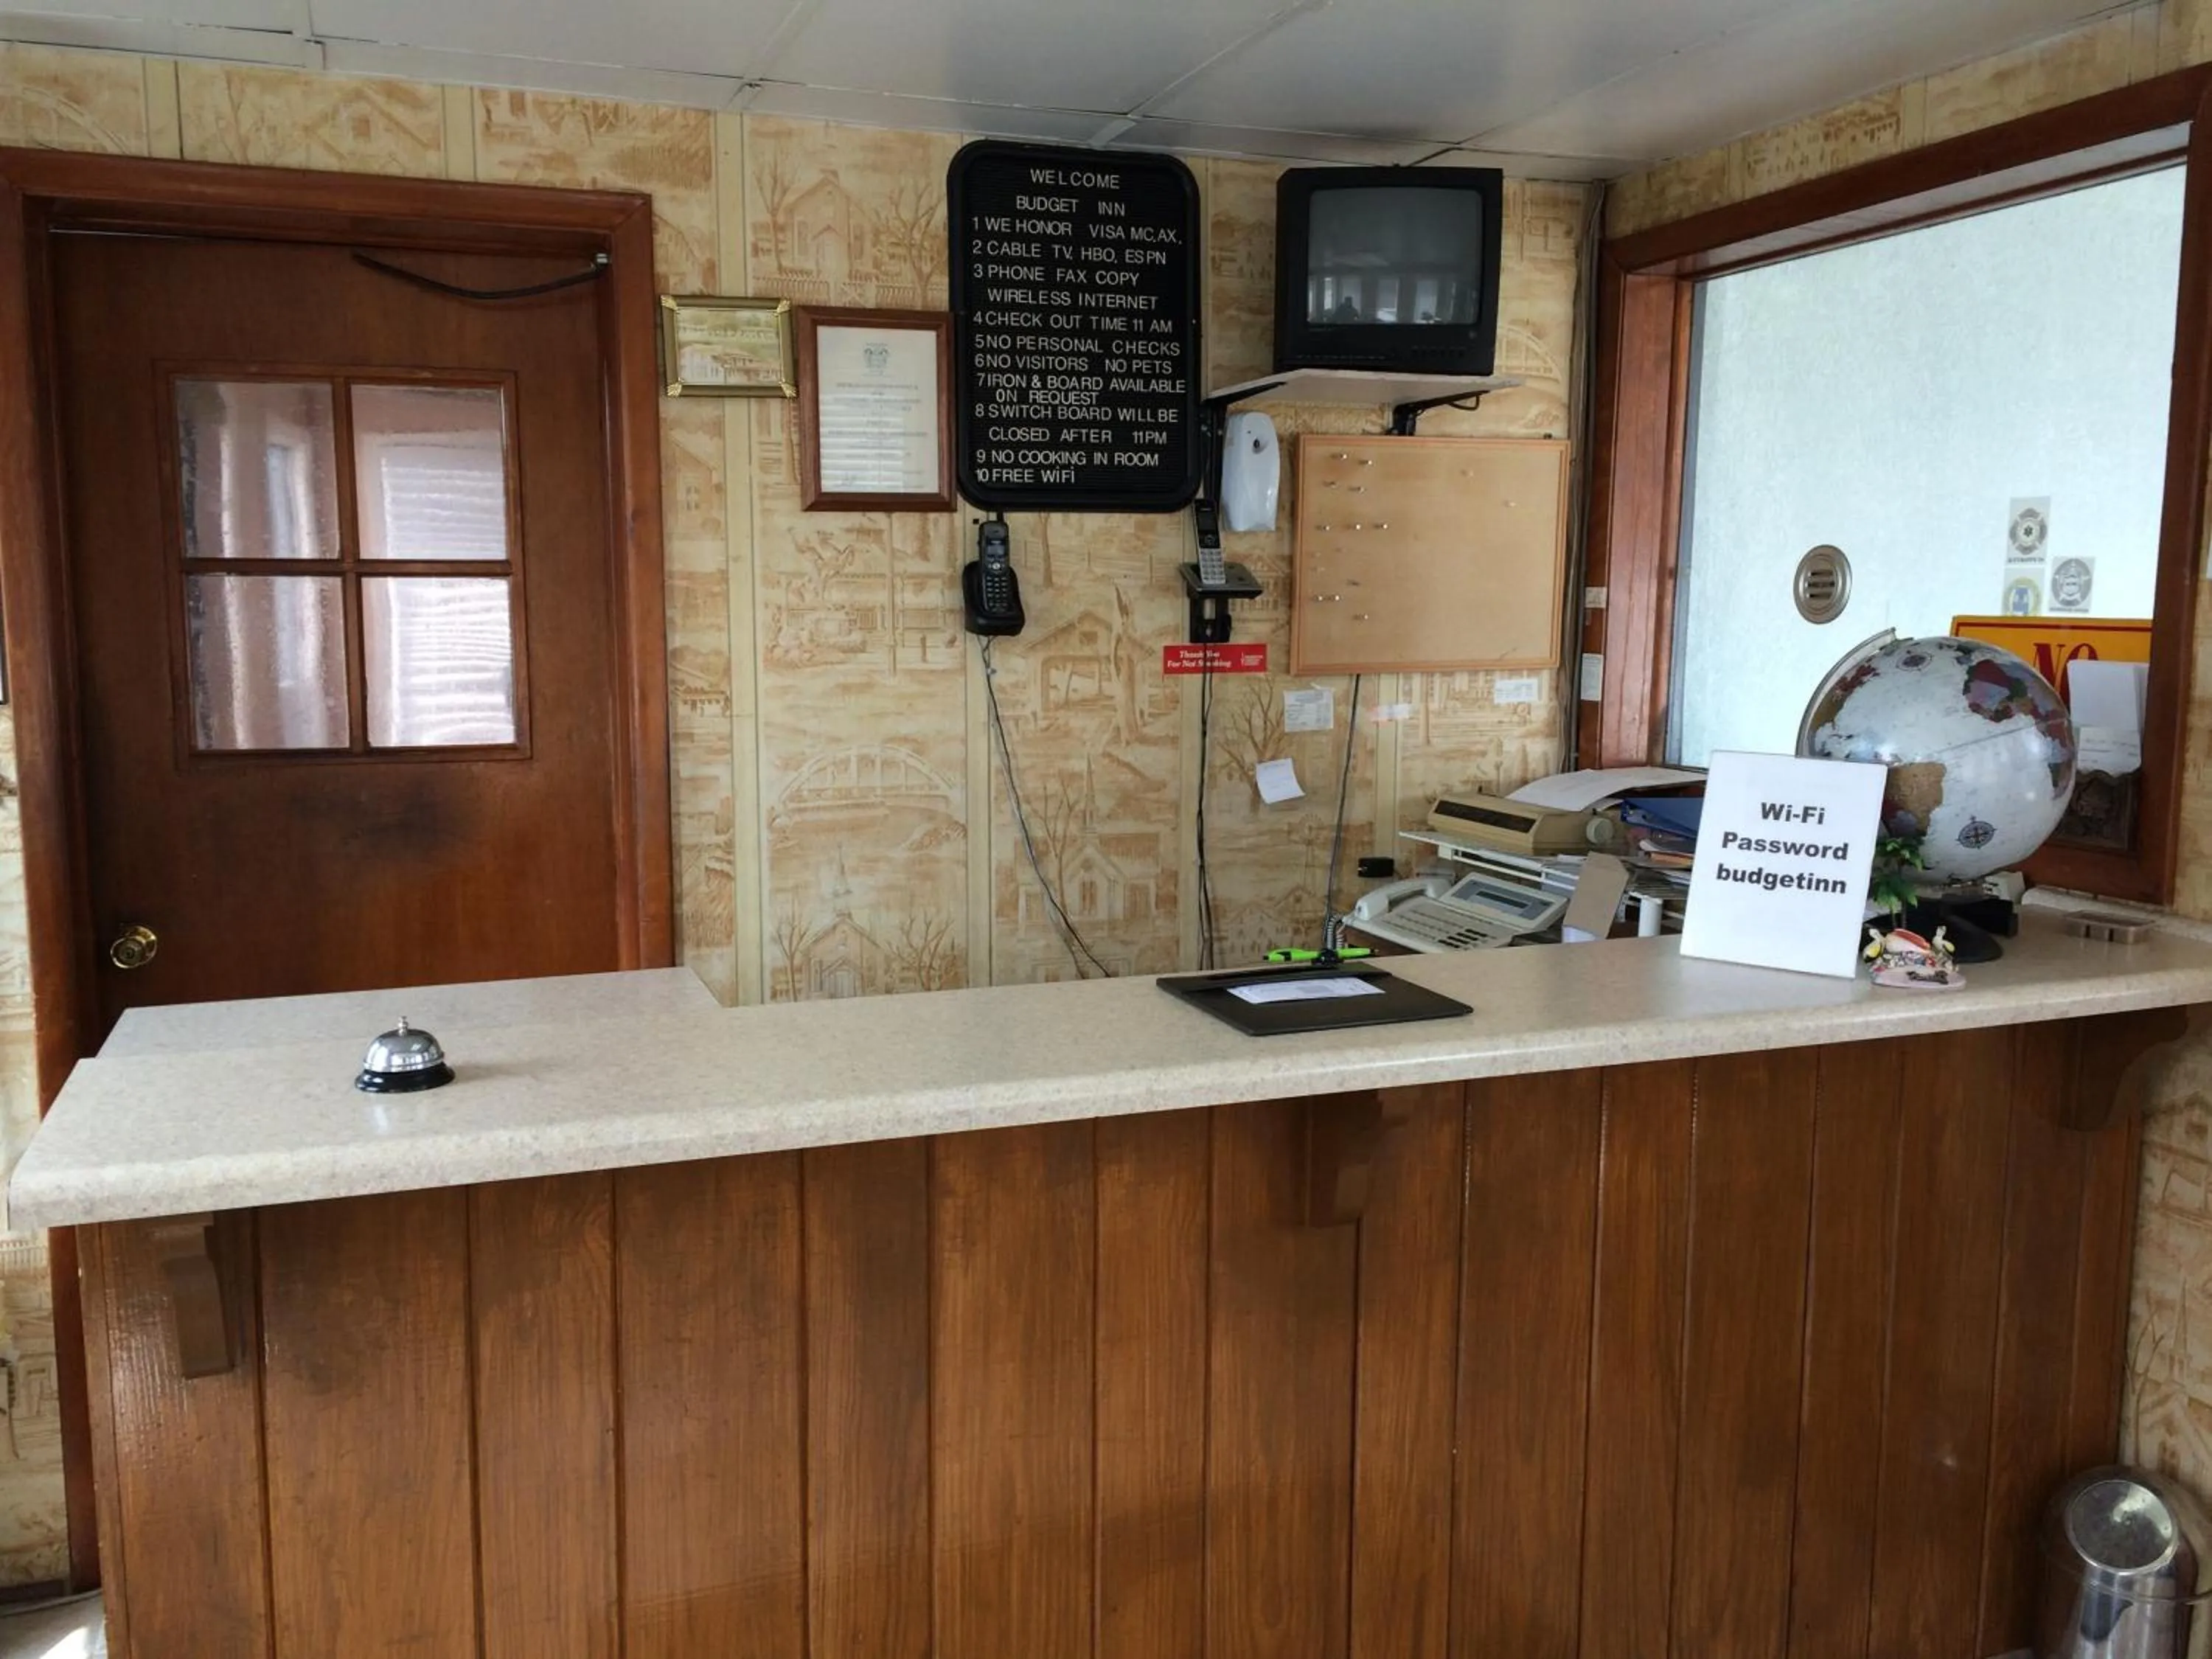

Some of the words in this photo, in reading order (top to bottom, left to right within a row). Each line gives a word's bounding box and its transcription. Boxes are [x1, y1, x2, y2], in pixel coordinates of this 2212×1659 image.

[1031, 170, 1119, 189] WELCOME
[1017, 196, 1078, 212] BUDGET
[1098, 201, 1124, 216] INN
[973, 218, 978, 230] 1
[985, 217, 1010, 232] WE
[1015, 219, 1072, 235] HONOR
[1089, 223, 1125, 239] VISA
[973, 240, 982, 254] 2
[987, 241, 1040, 257] CABLE
[1125, 248, 1166, 265] ESPN
[973, 264, 983, 278] 3
[988, 265, 1044, 281] PHONE
[1057, 268, 1087, 283] FAX
[1095, 271, 1139, 286] COPY
[988, 288, 1071, 306] WIRELESS
[1079, 293, 1158, 310] INTERNET
[973, 311, 982, 324] 4
[986, 310, 1042, 327] CHECK
[1050, 313, 1082, 329] OUT
[1090, 316, 1127, 331] TIME
[1133, 318, 1144, 330] 11
[1150, 319, 1172, 333] AM
[975, 334, 984, 348] 5
[987, 335, 1011, 349] NO
[1017, 335, 1103, 353] PERSONAL
[1112, 340, 1180, 356] CHECKS
[975, 353, 984, 367] 6
[987, 354, 1011, 369] NO
[1015, 355, 1088, 372] VISITORS
[1105, 359, 1127, 372] NO
[1132, 359, 1172, 375] PETS
[977, 372, 985, 386] 7
[987, 373, 1026, 388] IRON
[1031, 375, 1042, 389] &
[1047, 375, 1104, 391] BOARD
[1110, 378, 1186, 393] AVAILABLE
[1029, 389, 1099, 406] REQUEST
[975, 403, 984, 418] 8
[988, 403, 1052, 420] SWITCH
[1057, 406, 1112, 421] BOARD
[1117, 407, 1155, 422] WILL
[1158, 408, 1179, 422] BE
[989, 426, 1050, 442] CLOSED
[1060, 428, 1112, 443] AFTER
[976, 449, 986, 464] 9
[991, 449, 1015, 464] NO
[1018, 450, 1086, 466] COOKING
[1093, 452, 1107, 465] IN
[1114, 452, 1159, 467] ROOM
[975, 468, 990, 482] 10
[992, 468, 1034, 483] FREE
[1167, 660, 1181, 668] For
[1182, 659, 1196, 668] Not
[1760, 801, 1826, 825] Wi-Fi
[1722, 831, 1849, 860] Password
[1716, 863, 1847, 894] budgetinn
